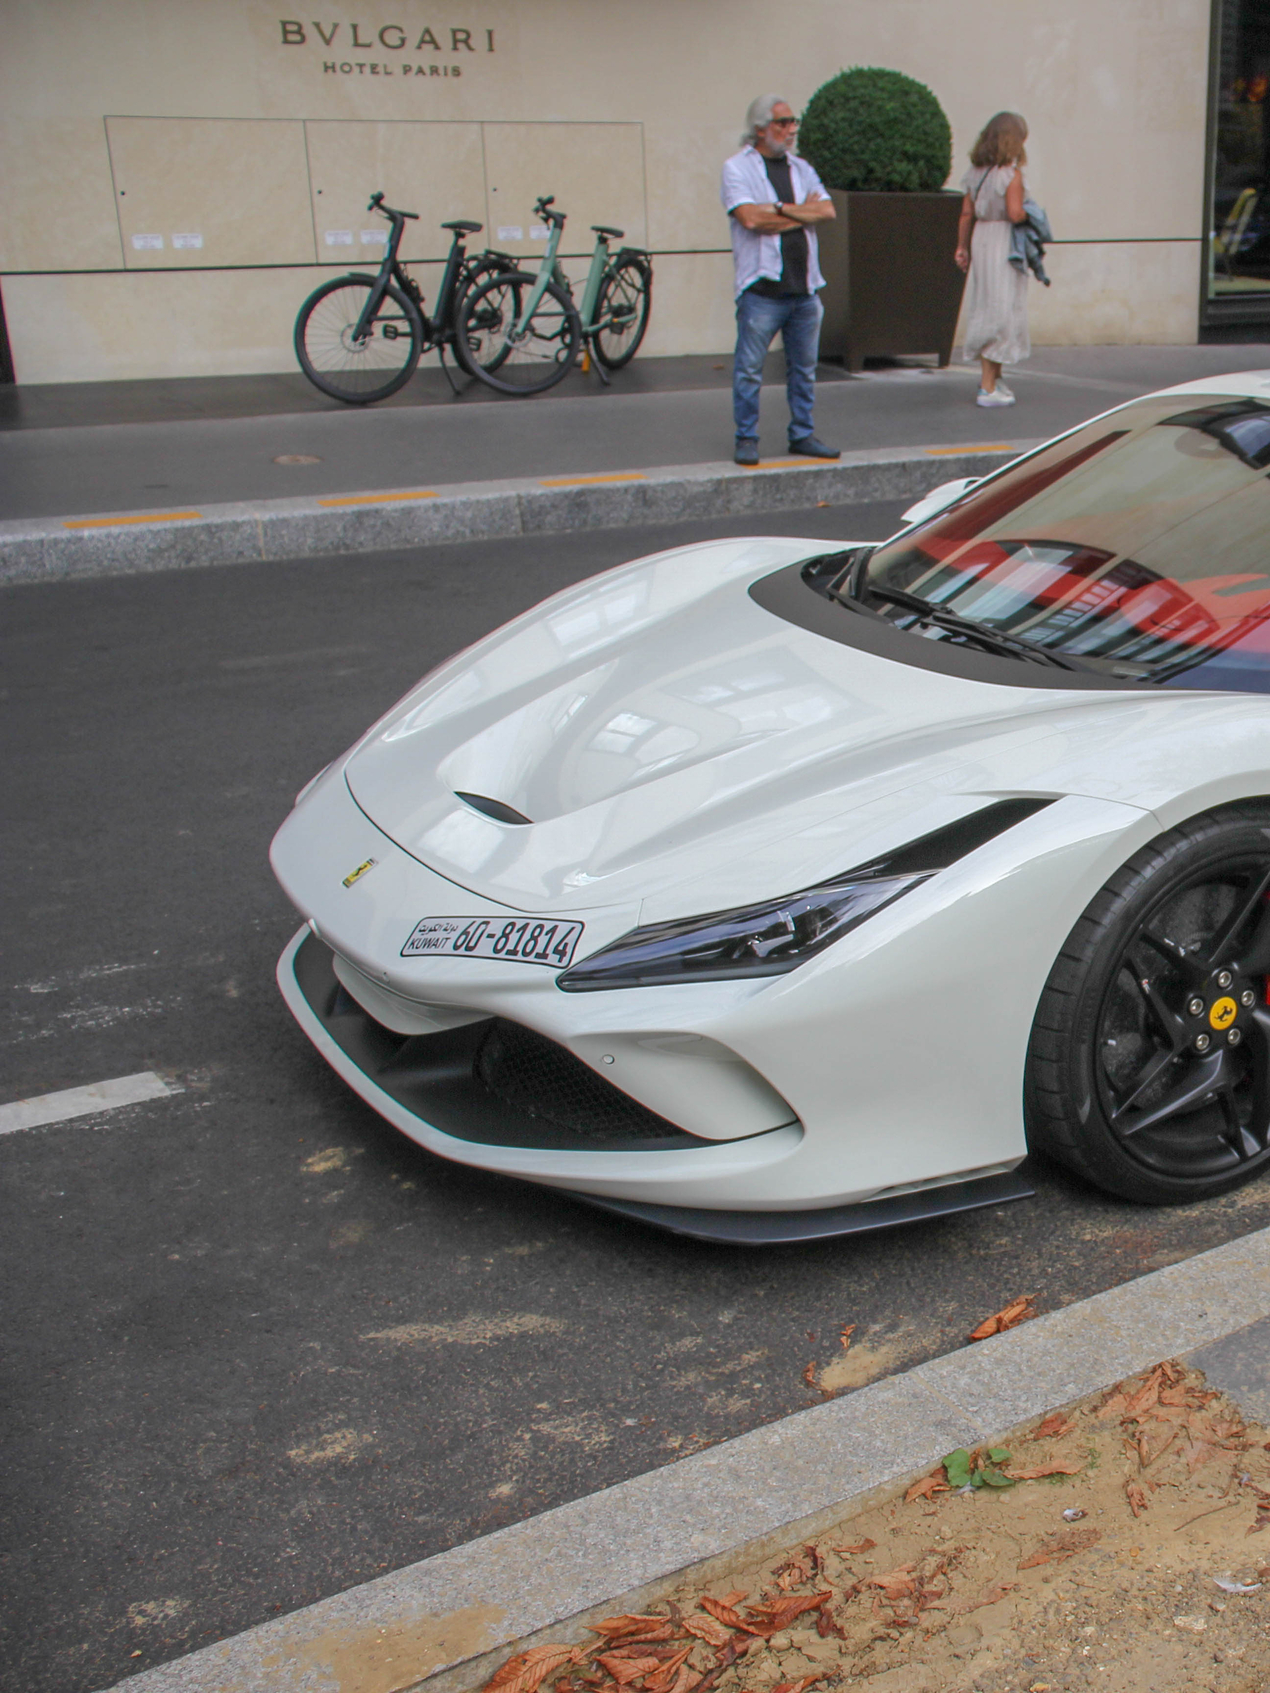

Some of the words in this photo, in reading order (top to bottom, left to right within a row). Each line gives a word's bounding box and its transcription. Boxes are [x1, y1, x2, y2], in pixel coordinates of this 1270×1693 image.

[279, 20, 496, 52] BVLGARI
[323, 61, 393, 75] HOTEL
[402, 64, 462, 77] PARIS
[407, 937, 451, 950] KUWAIT
[452, 920, 576, 963] 60-81814
